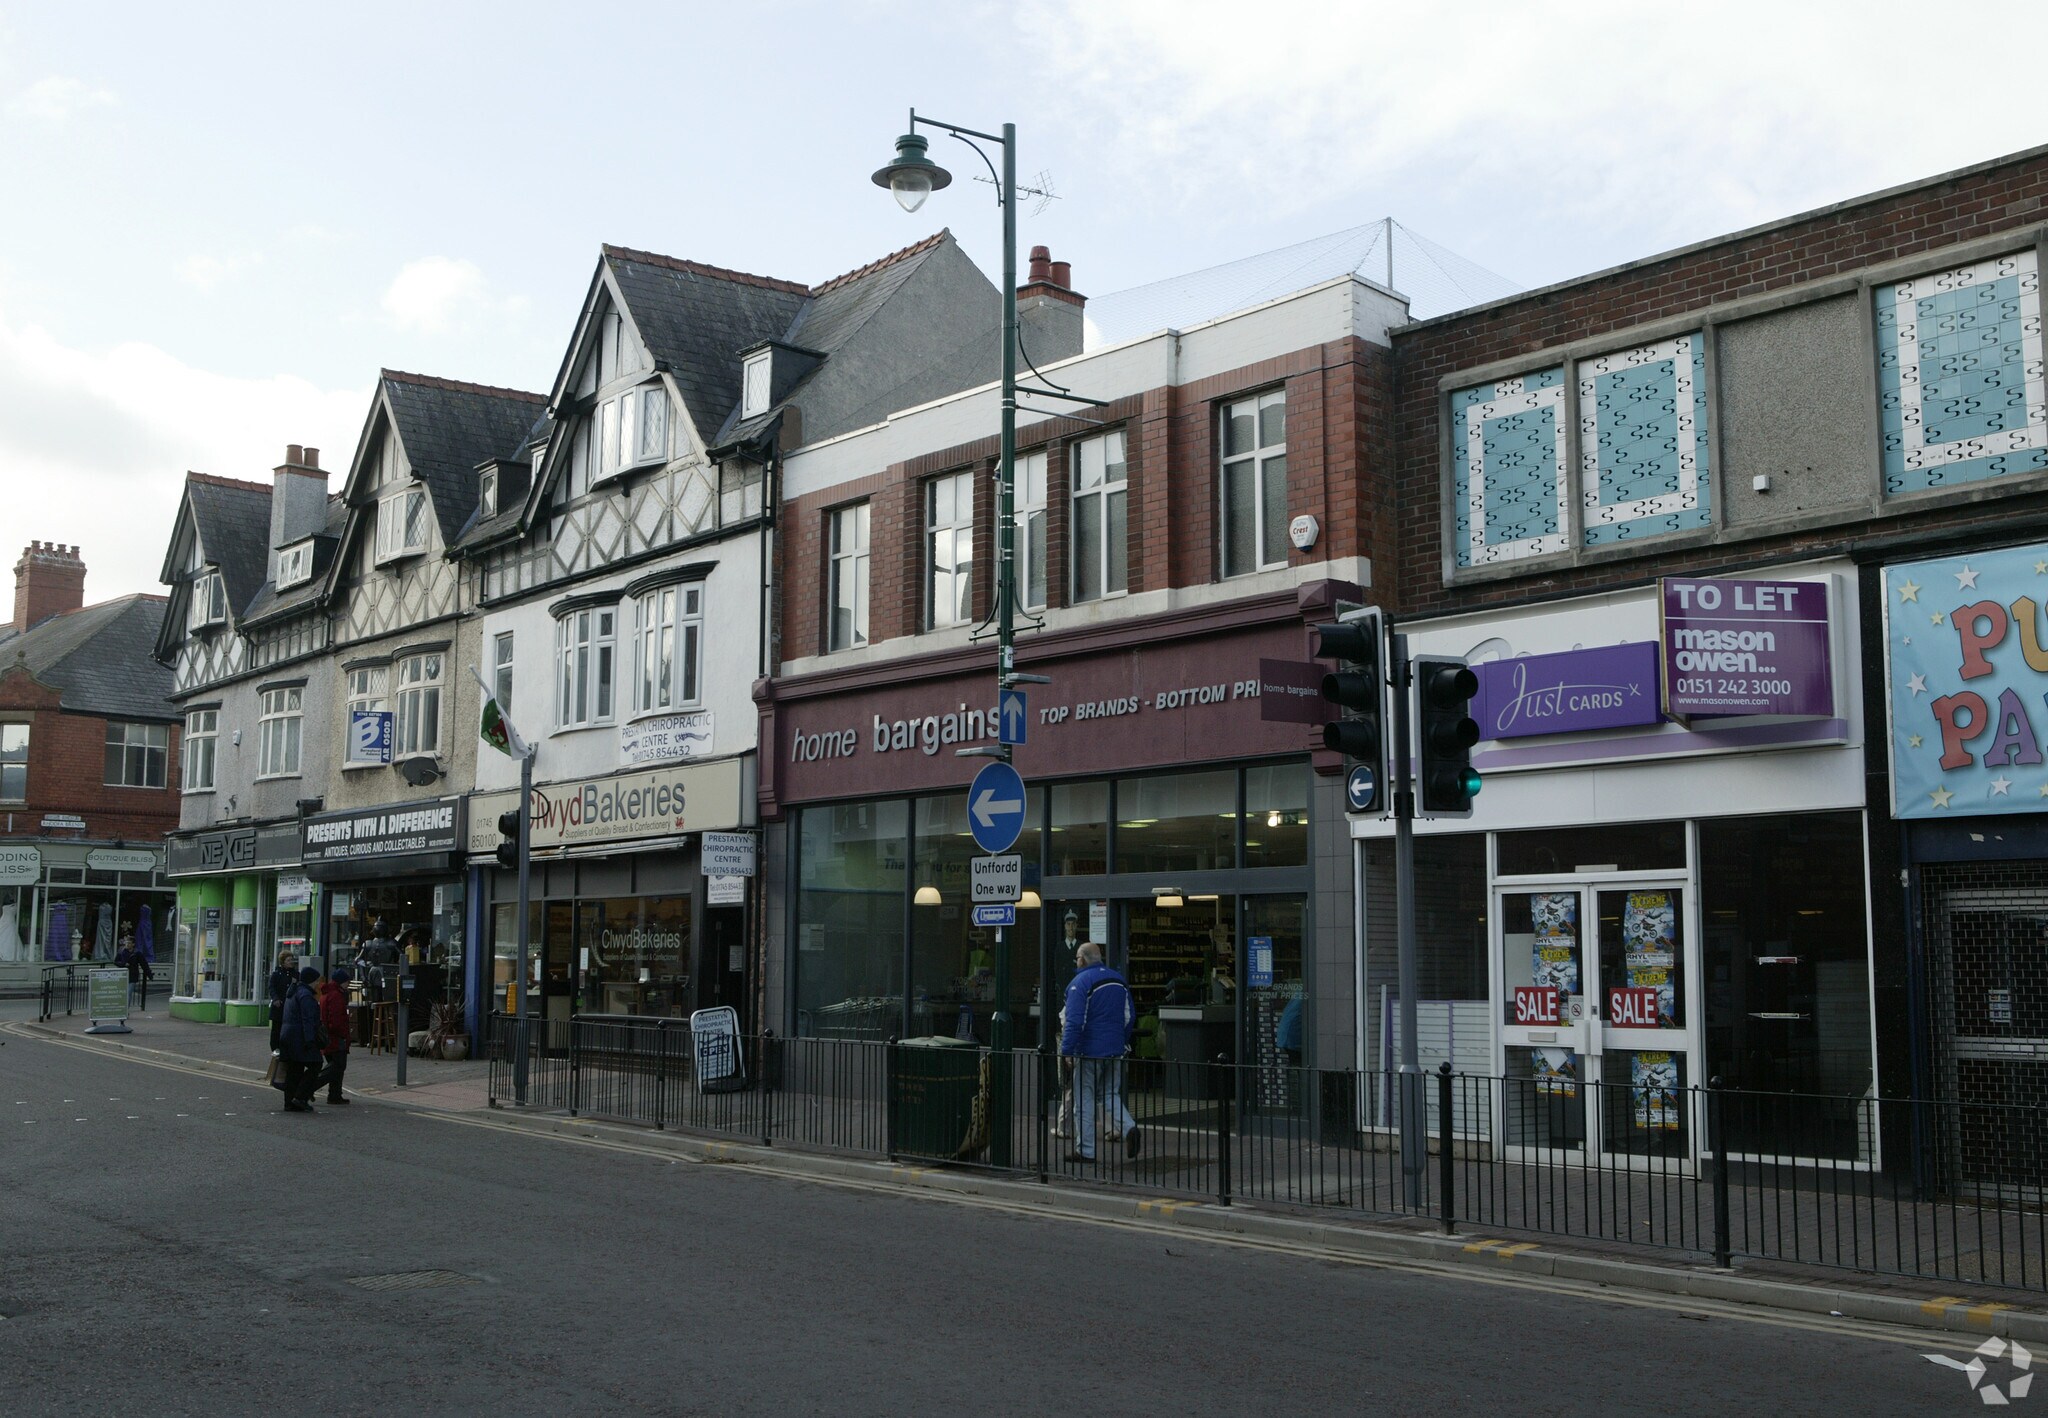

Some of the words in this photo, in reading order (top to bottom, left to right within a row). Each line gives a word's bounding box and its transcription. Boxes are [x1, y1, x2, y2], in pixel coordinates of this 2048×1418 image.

[1673, 585, 1722, 610] TO
[1734, 587, 1799, 612] LET
[1674, 628, 1776, 652] mason
[1263, 684, 1285, 694] home
[1287, 687, 1318, 697] bargains
[1676, 678, 1713, 694] 0151
[1717, 679, 1748, 695] 242
[1751, 680, 1792, 696] 3000
[1569, 690, 1623, 712] CARDS
[1677, 696, 1770, 706] www.masonowen.com
[648, 713, 711, 733] CHIROPRACTIC
[791, 727, 857, 763] home
[873, 702, 1000, 756] bargains
[1039, 704, 1070, 726] TOP
[1074, 694, 1140, 721] BRANDS
[1154, 682, 1227, 711] BOTTOM
[1930, 687, 2048, 772] PA
[383, 721, 391, 746] OSOD
[641, 733, 668, 749] CENTRE
[382, 747, 391, 761] AR
[656, 744, 690, 758] 854432
[307, 820, 353, 843] PRESENTS
[353, 815, 379, 839] WITH
[378, 815, 387, 835] A
[388, 806, 454, 834] DIFFERENCE
[476, 817, 493, 829] 01745
[565, 828, 590, 840] Suppliers
[591, 826, 596, 837] of
[594, 822, 613, 837] Quality
[612, 820, 630, 834] Bread
[629, 821, 634, 832] &
[635, 815, 671, 832] Confectionery
[471, 833, 497, 849] 850100
[708, 834, 749, 844] PRESTATYN
[200, 829, 256, 870] NEXUS
[323, 844, 351, 859] ANTIQUES,
[349, 841, 373, 856] CURIOUS
[372, 839, 385, 852] AND
[384, 836, 427, 851] COLLECTABLES
[702, 844, 754, 854] CHIROPRACTIC
[88, 854, 129, 862] BOUTIQUE
[714, 855, 742, 864] CENTRE
[730, 867, 753, 875] 854432
[974, 861, 1018, 874] Unffordd
[975, 883, 994, 895] One
[997, 884, 1016, 895] way
[1631, 894, 1666, 909] EXTREME
[602, 928, 680, 953] ClwydBakeries
[1272, 983, 1303, 991] BRANDS
[1280, 992, 1310, 1000] PRICES
[1516, 992, 1558, 1021] SALE
[1612, 993, 1656, 1024] SALE
